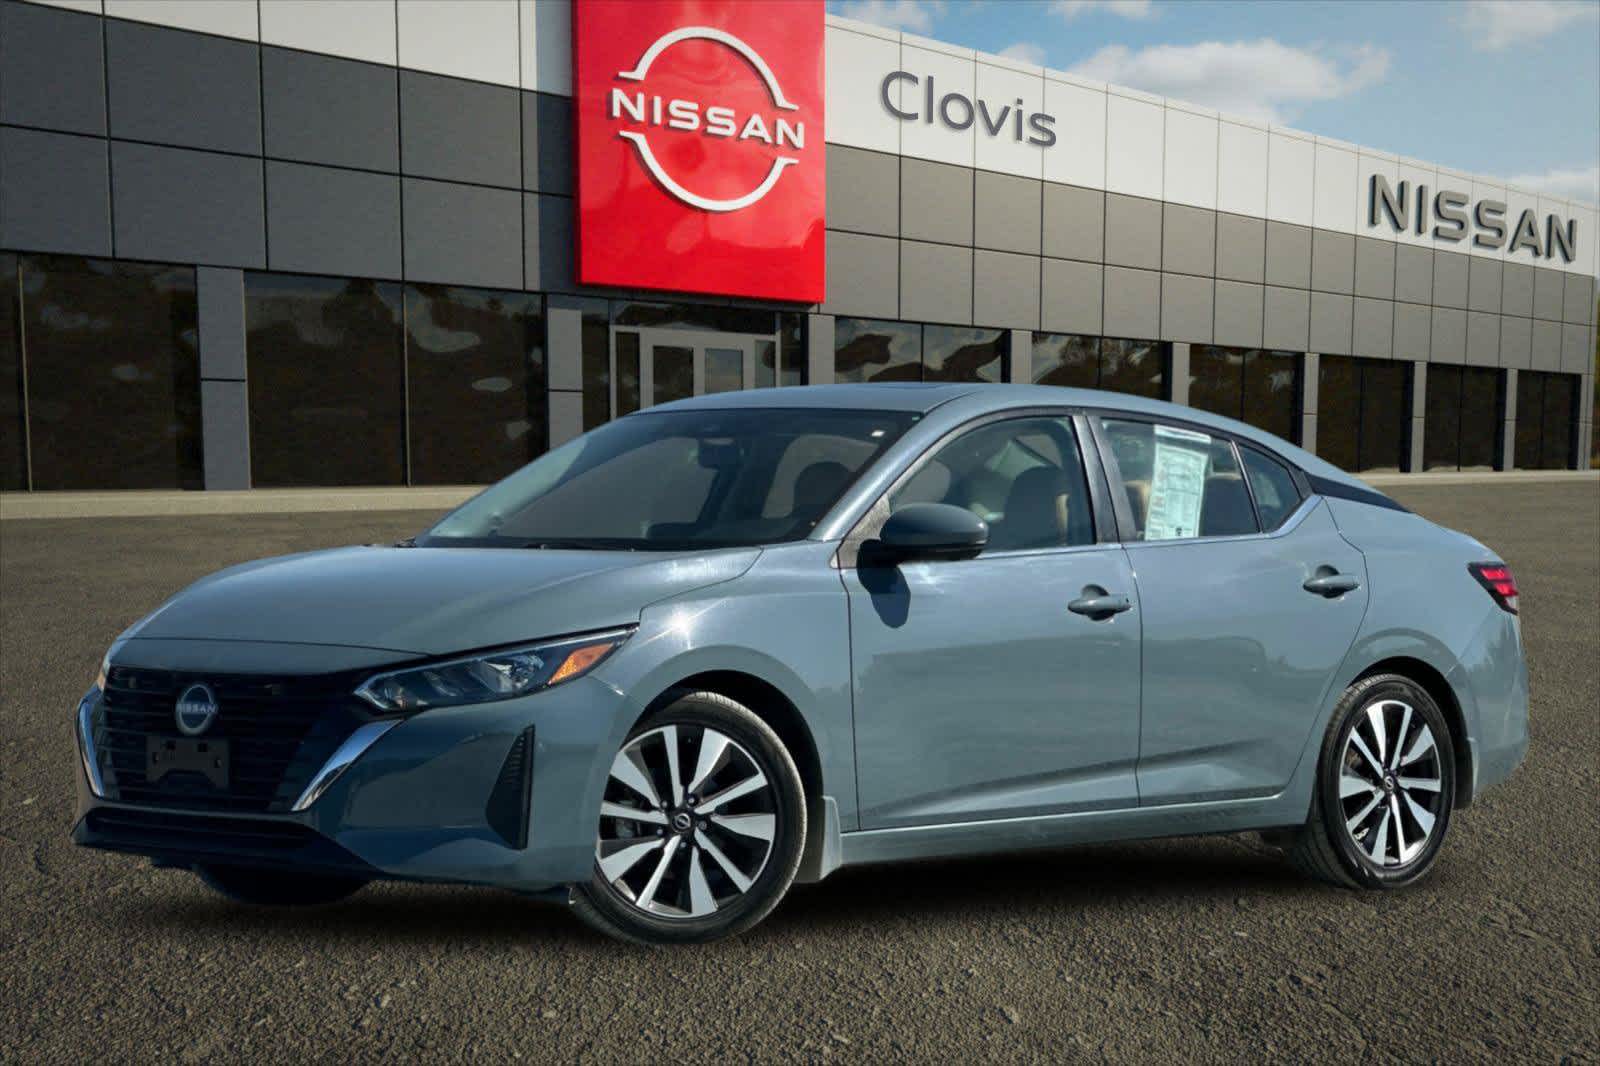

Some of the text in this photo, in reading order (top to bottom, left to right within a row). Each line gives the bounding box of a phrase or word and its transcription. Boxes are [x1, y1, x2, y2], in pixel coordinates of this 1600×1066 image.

[611, 87, 805, 149] NISSAN
[881, 70, 1057, 147] Clovis
[1368, 173, 1578, 263] NISSAN
